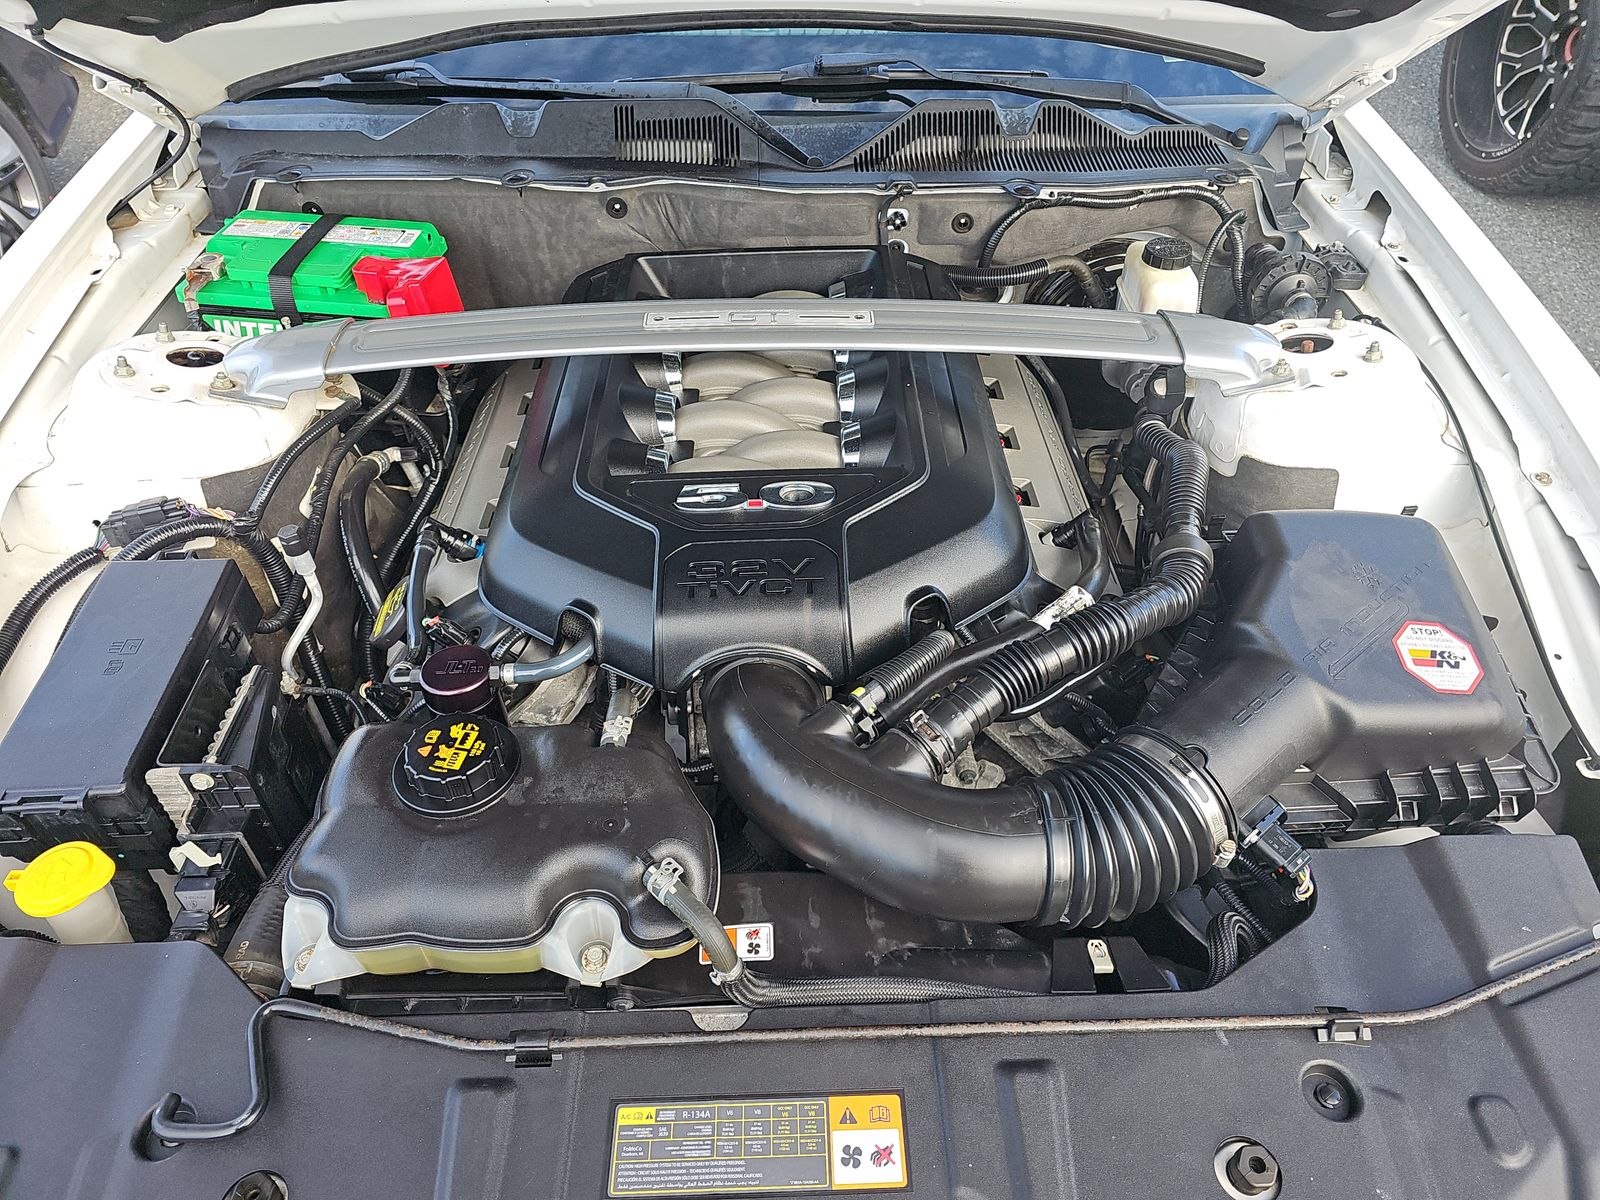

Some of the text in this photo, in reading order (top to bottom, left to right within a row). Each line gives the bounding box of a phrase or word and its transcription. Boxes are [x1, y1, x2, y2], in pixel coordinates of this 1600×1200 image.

[728, 311, 790, 324] GT
[213, 319, 283, 338] INTE
[673, 480, 838, 513] 5.0
[688, 557, 816, 578] 32V
[1302, 638, 1338, 664] AIR
[682, 1109, 710, 1119] R-134A
